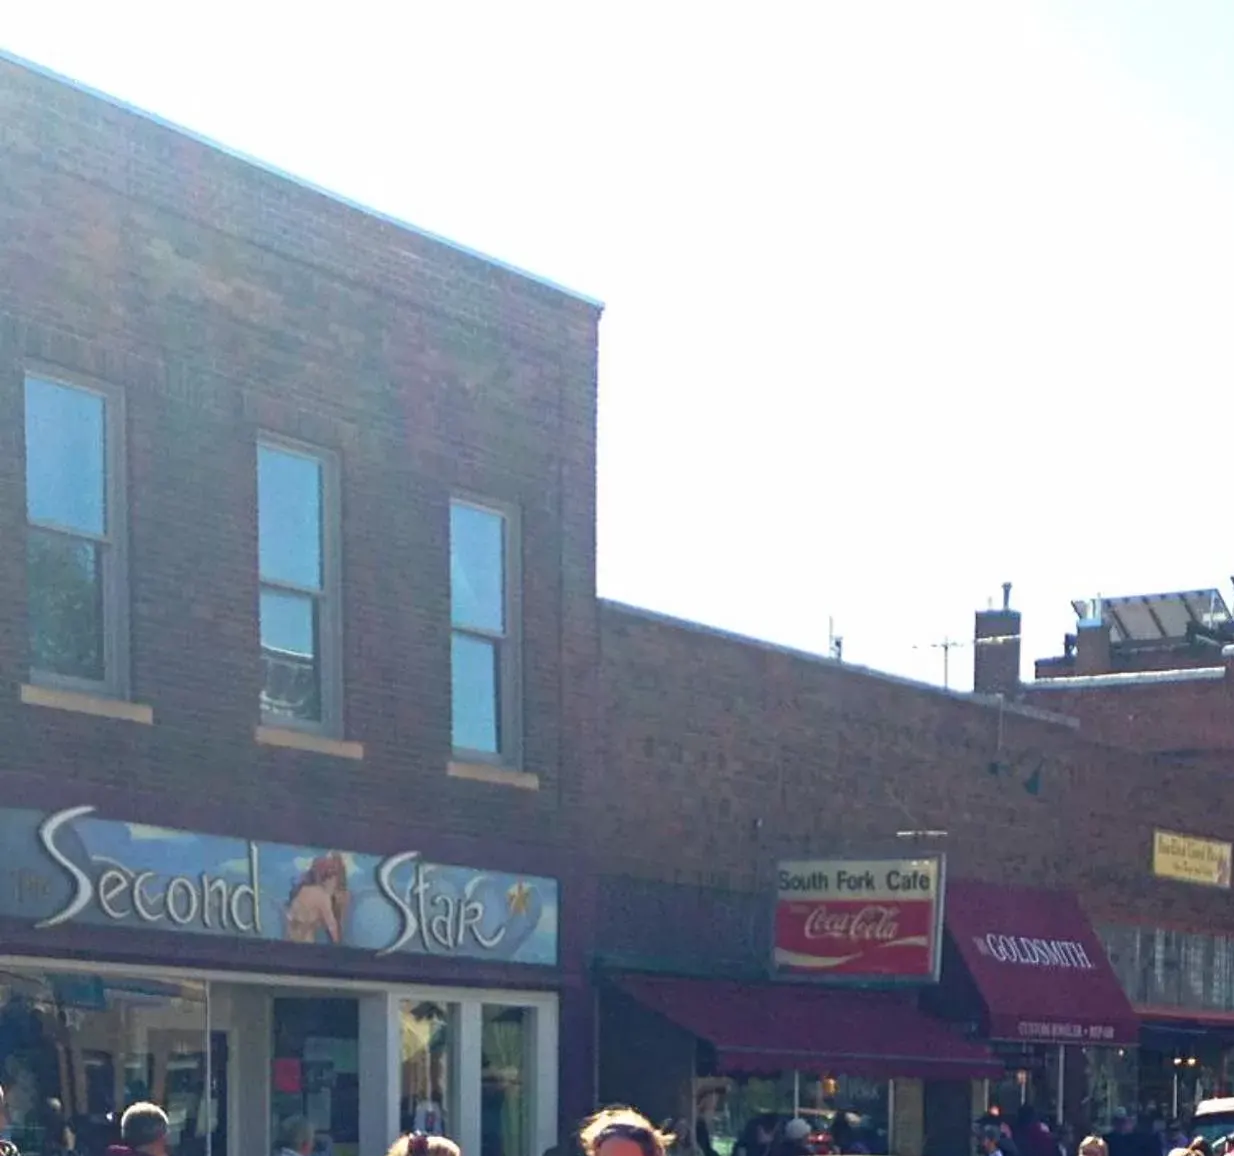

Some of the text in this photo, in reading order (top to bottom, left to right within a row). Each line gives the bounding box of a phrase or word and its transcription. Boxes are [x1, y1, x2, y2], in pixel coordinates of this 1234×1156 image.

[34, 805, 262, 932] Second
[778, 870, 930, 892] South Fork Cafe
[986, 933, 1093, 968] GOLDSMITH
